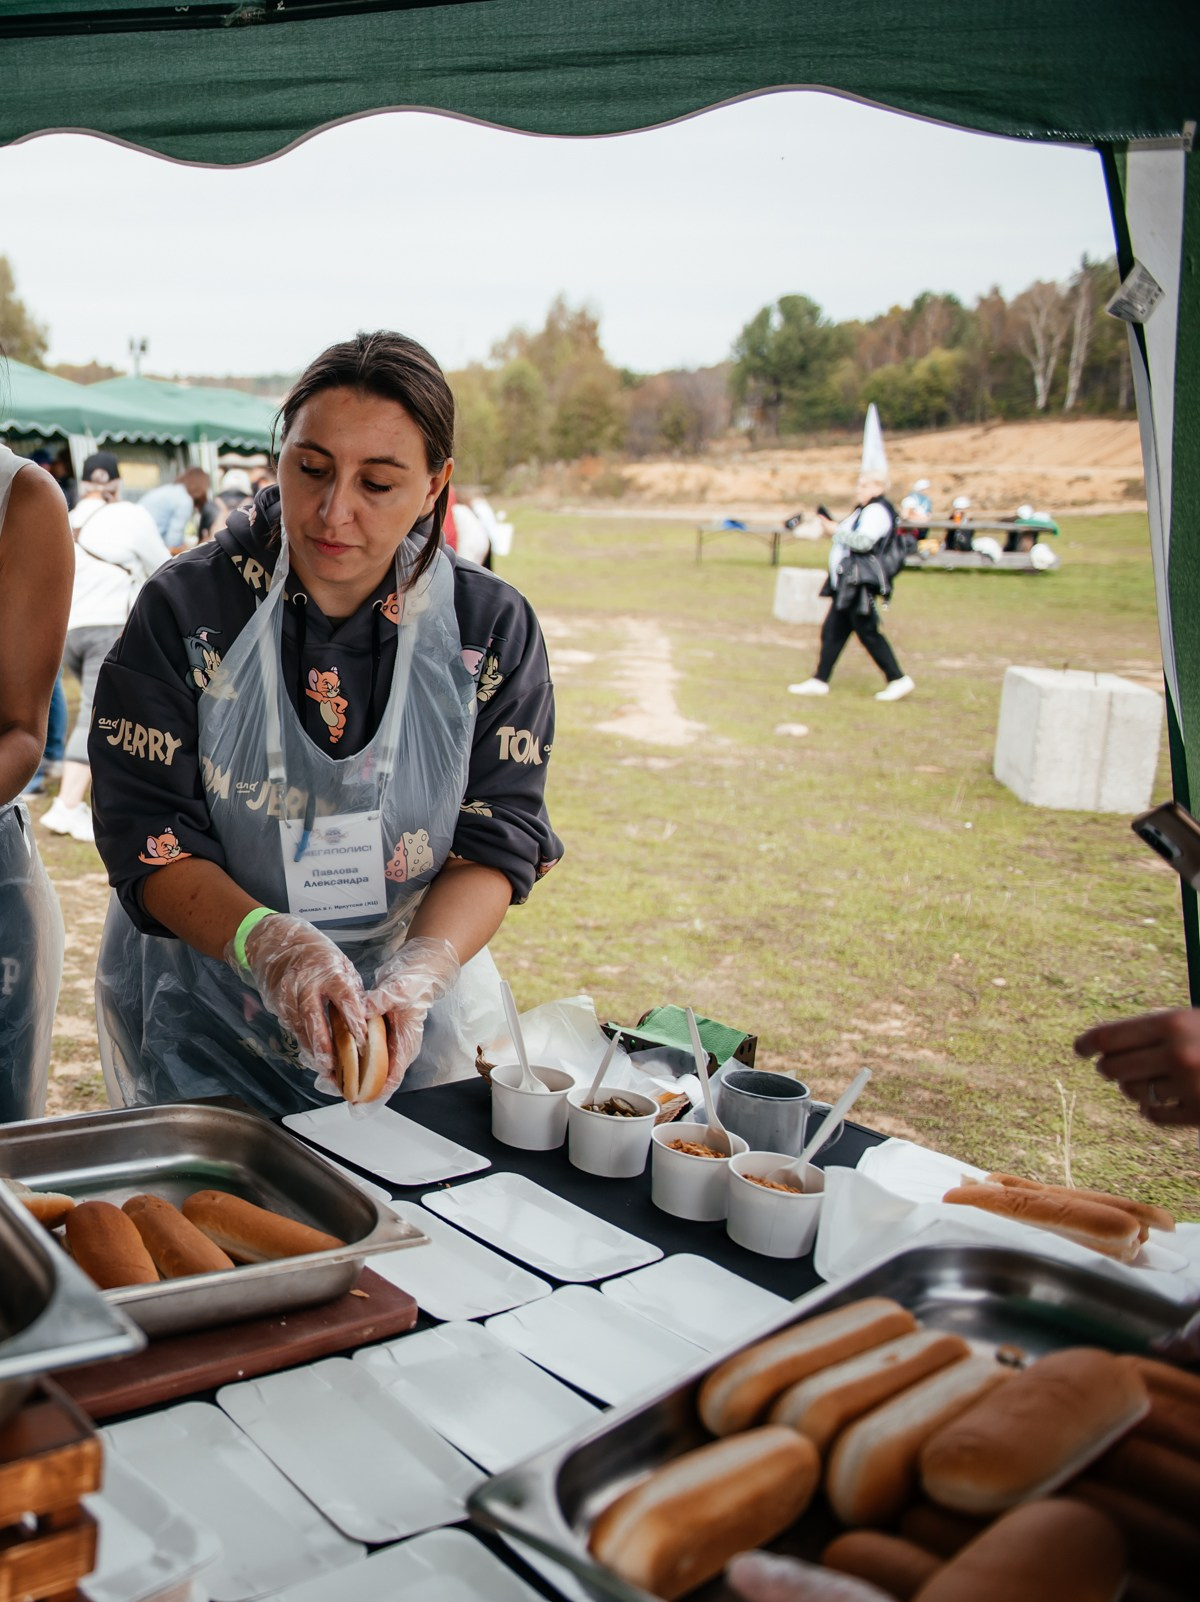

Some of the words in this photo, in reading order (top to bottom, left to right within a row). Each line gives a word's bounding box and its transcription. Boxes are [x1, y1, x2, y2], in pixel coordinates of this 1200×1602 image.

[98, 717, 119, 729] and
[106, 718, 183, 766] JERRY
[496, 726, 543, 766] TOM
[201, 756, 231, 800] OM
[236, 781, 259, 793] and
[303, 876, 369, 888] Александра
[312, 867, 359, 877] Павлова
